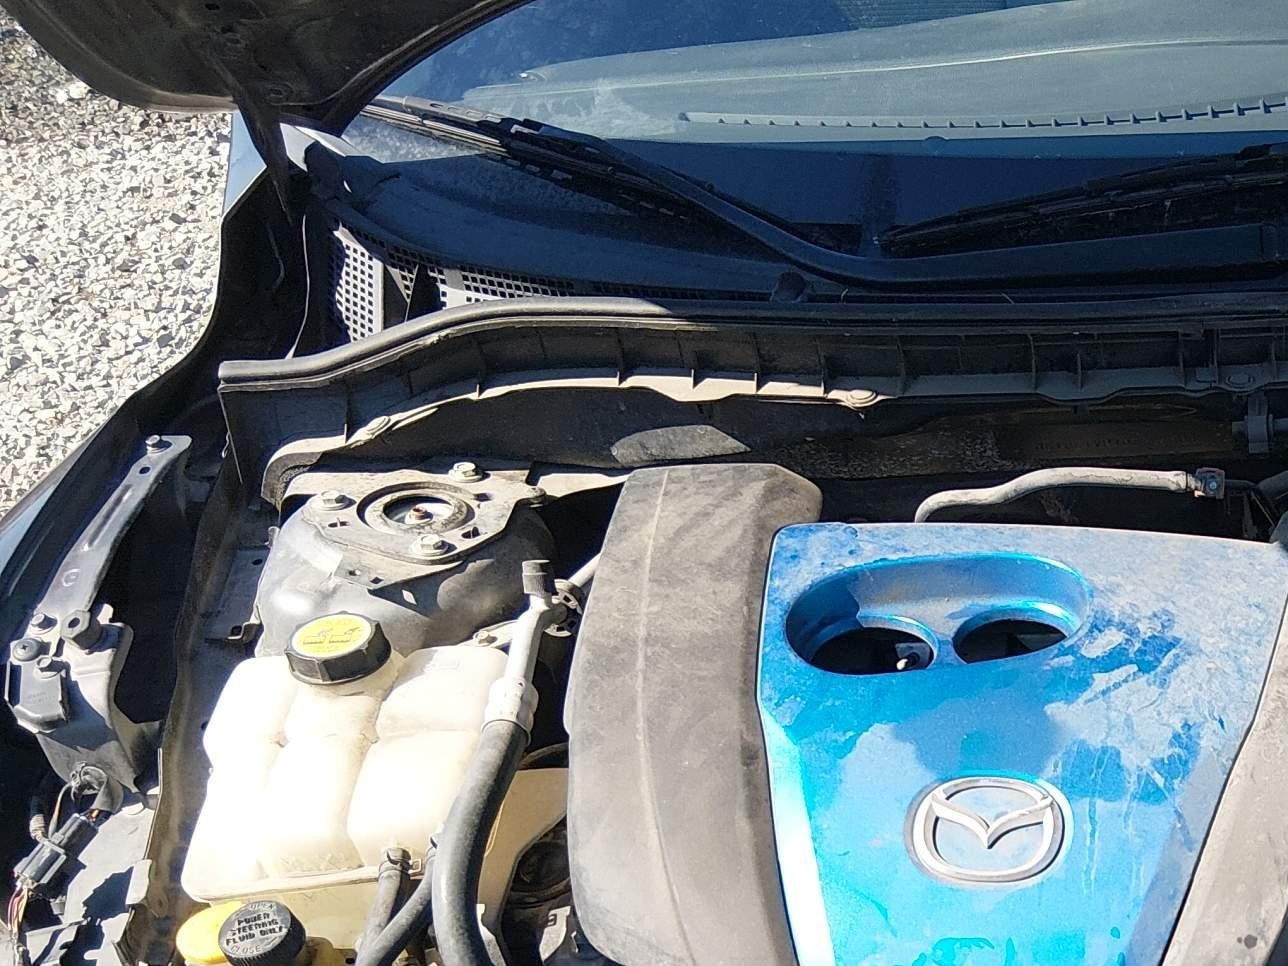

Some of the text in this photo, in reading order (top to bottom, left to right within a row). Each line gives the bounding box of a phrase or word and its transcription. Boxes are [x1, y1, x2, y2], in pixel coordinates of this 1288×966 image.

[230, 919, 279, 937] STEERING
[237, 912, 270, 926] POWER
[225, 926, 284, 946] FLUID ONLY
